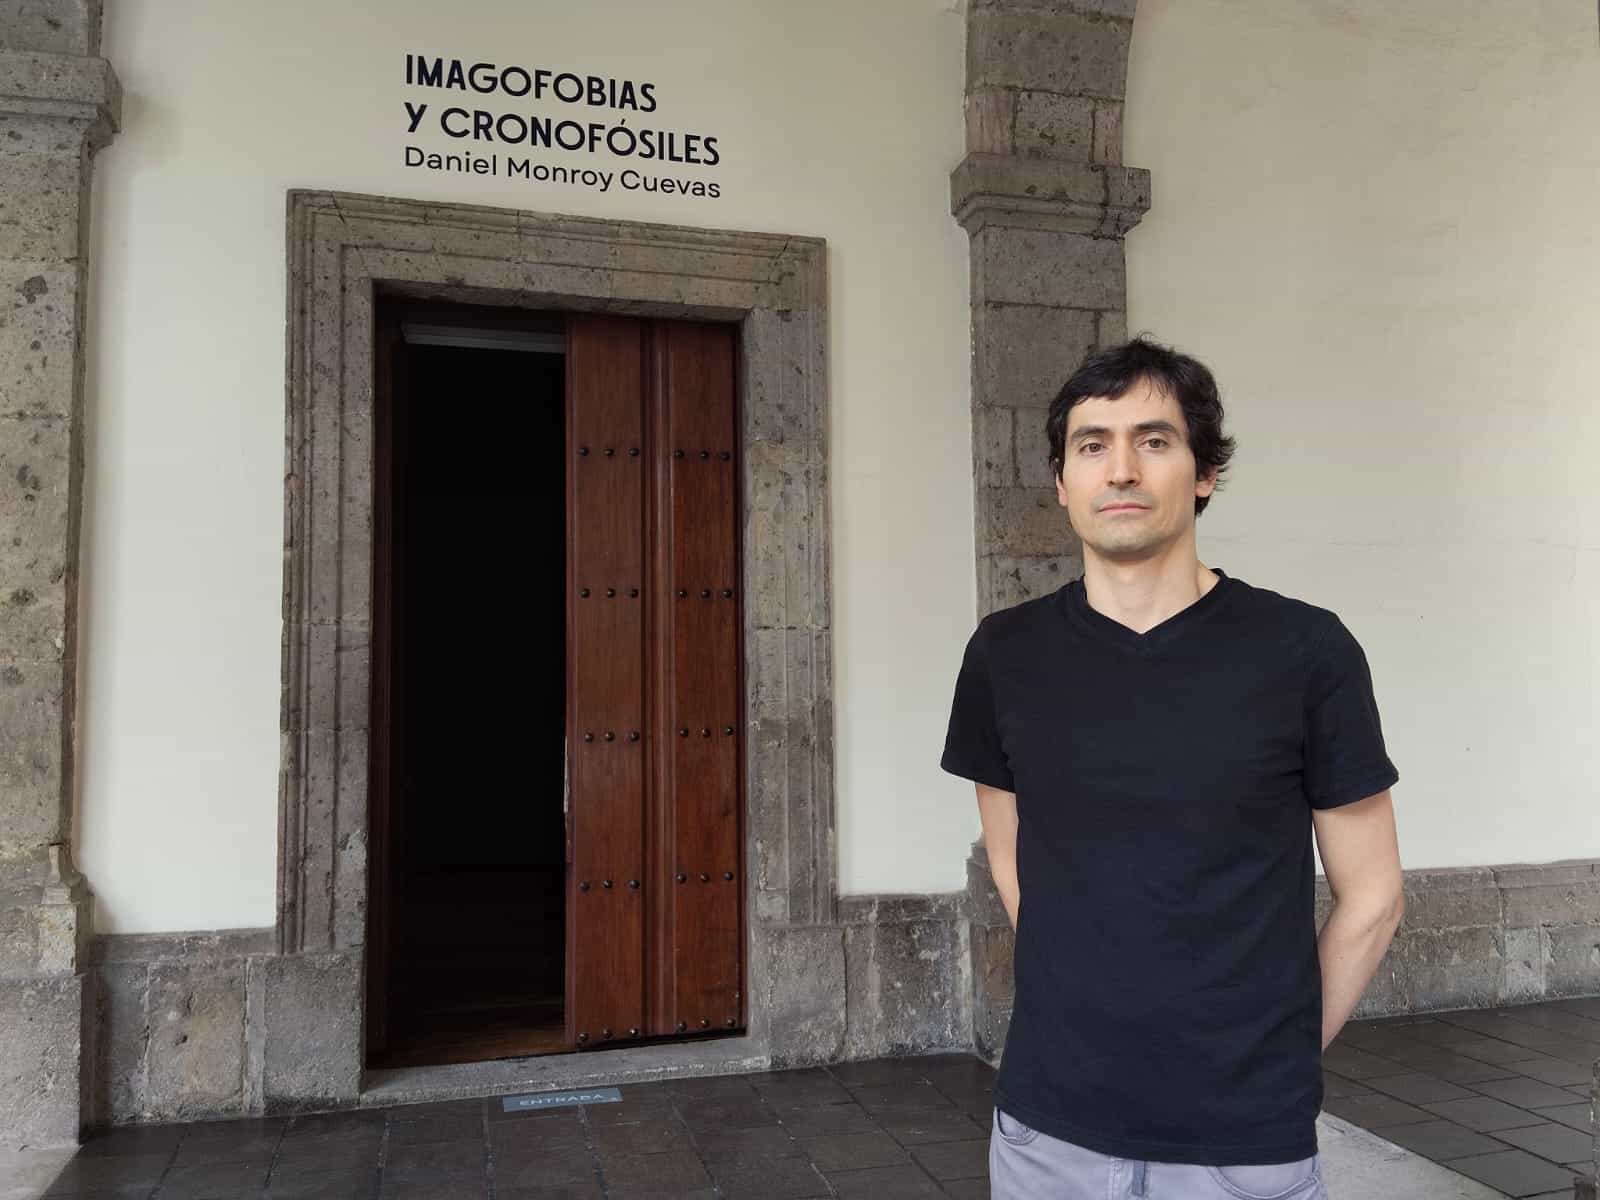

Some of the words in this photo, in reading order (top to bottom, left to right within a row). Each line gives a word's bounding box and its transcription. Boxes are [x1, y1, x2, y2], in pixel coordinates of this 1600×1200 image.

[406, 53, 657, 113] IMAGOFOBIAS
[440, 107, 720, 166] CRONOFÓSILES
[405, 146, 497, 176] Daniel
[507, 157, 614, 192] Monroy
[620, 169, 721, 199] Cuevas
[519, 1094, 605, 1106] ENTRADA
